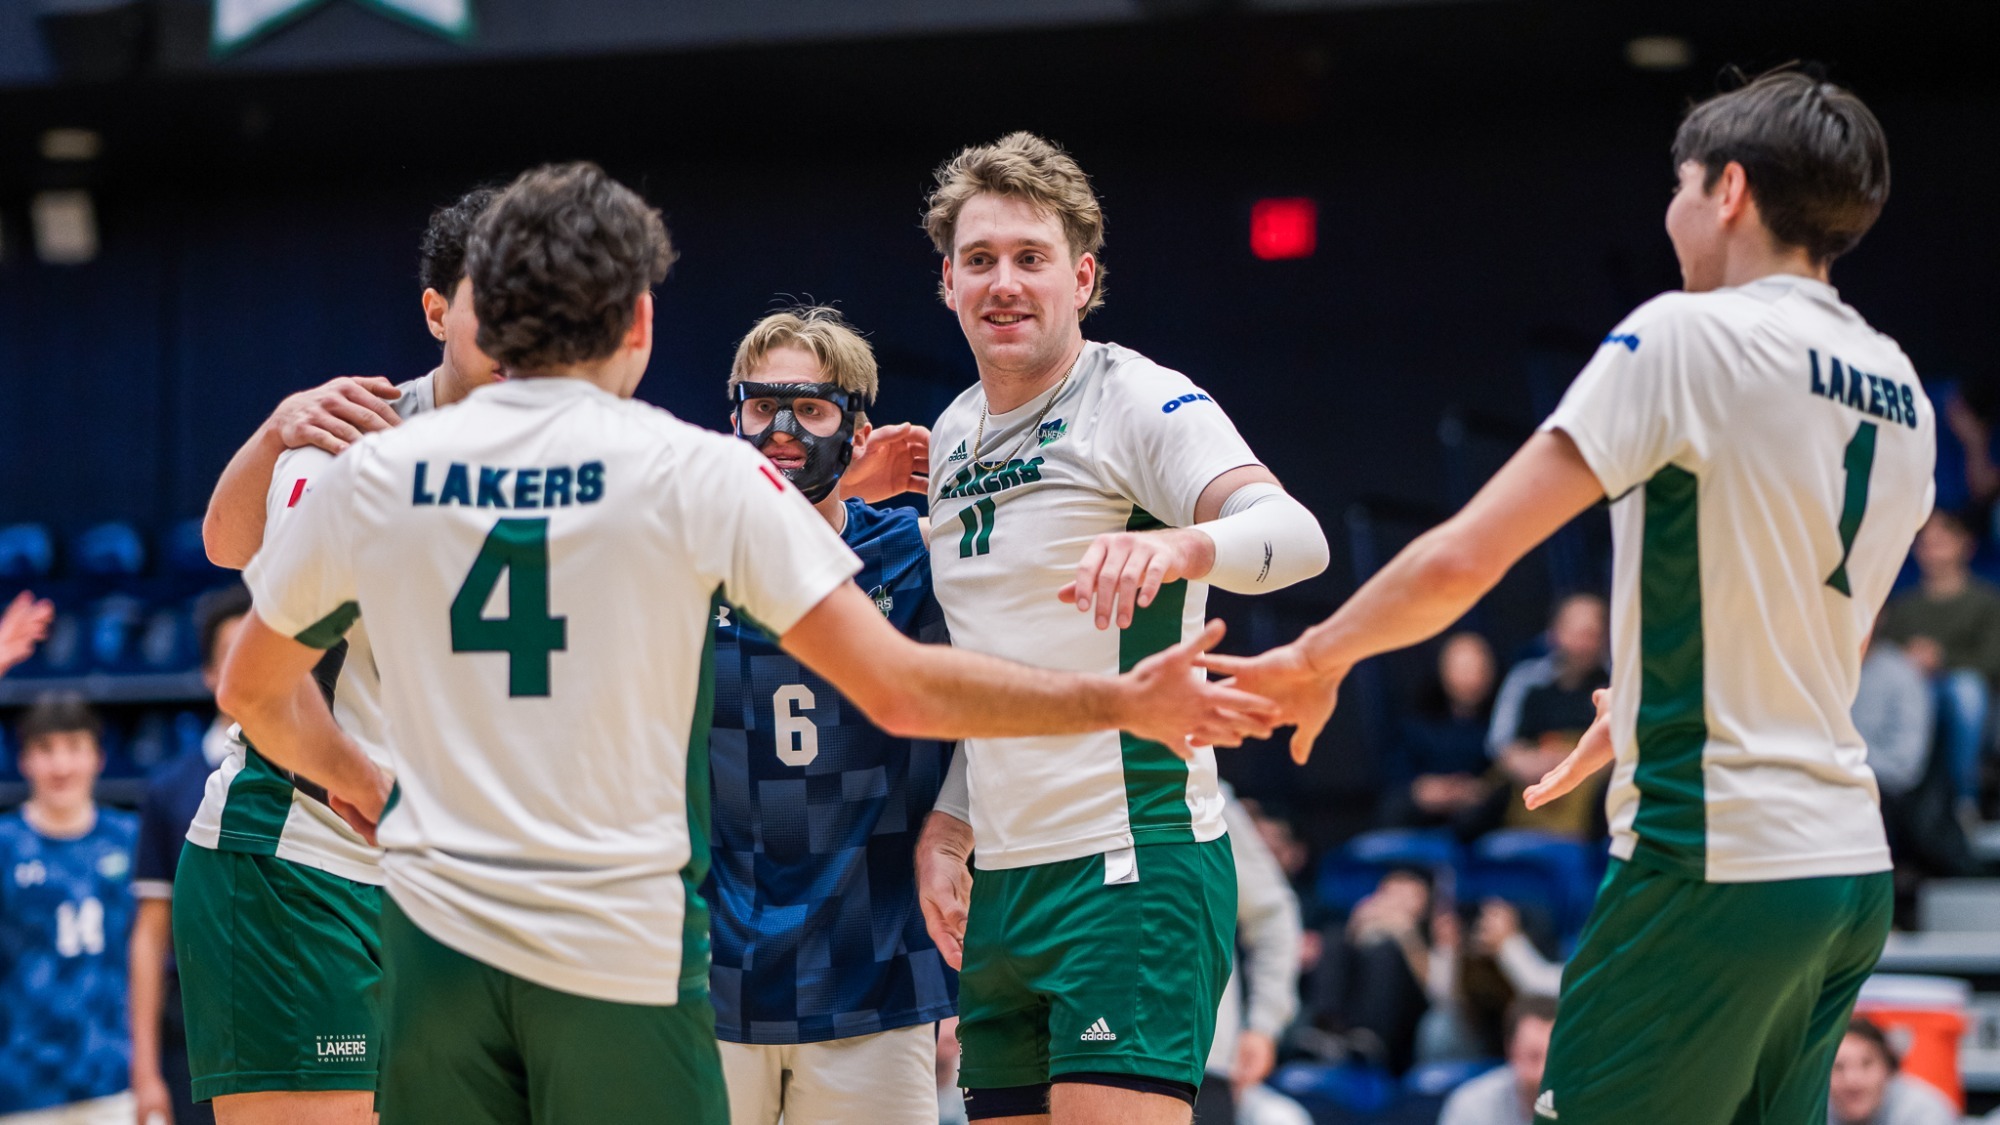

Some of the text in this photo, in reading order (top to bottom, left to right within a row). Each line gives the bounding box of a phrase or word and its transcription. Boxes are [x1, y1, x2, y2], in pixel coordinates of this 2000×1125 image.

[1809, 348, 1918, 430] LAKERS
[413, 461, 605, 509] LAKERS
[1825, 420, 1878, 597] 1
[958, 496, 997, 559] 11
[449, 517, 567, 698] 4
[772, 684, 819, 767] 6
[316, 1041, 366, 1056] LAKERS
[1080, 1031, 1117, 1041] adidas
